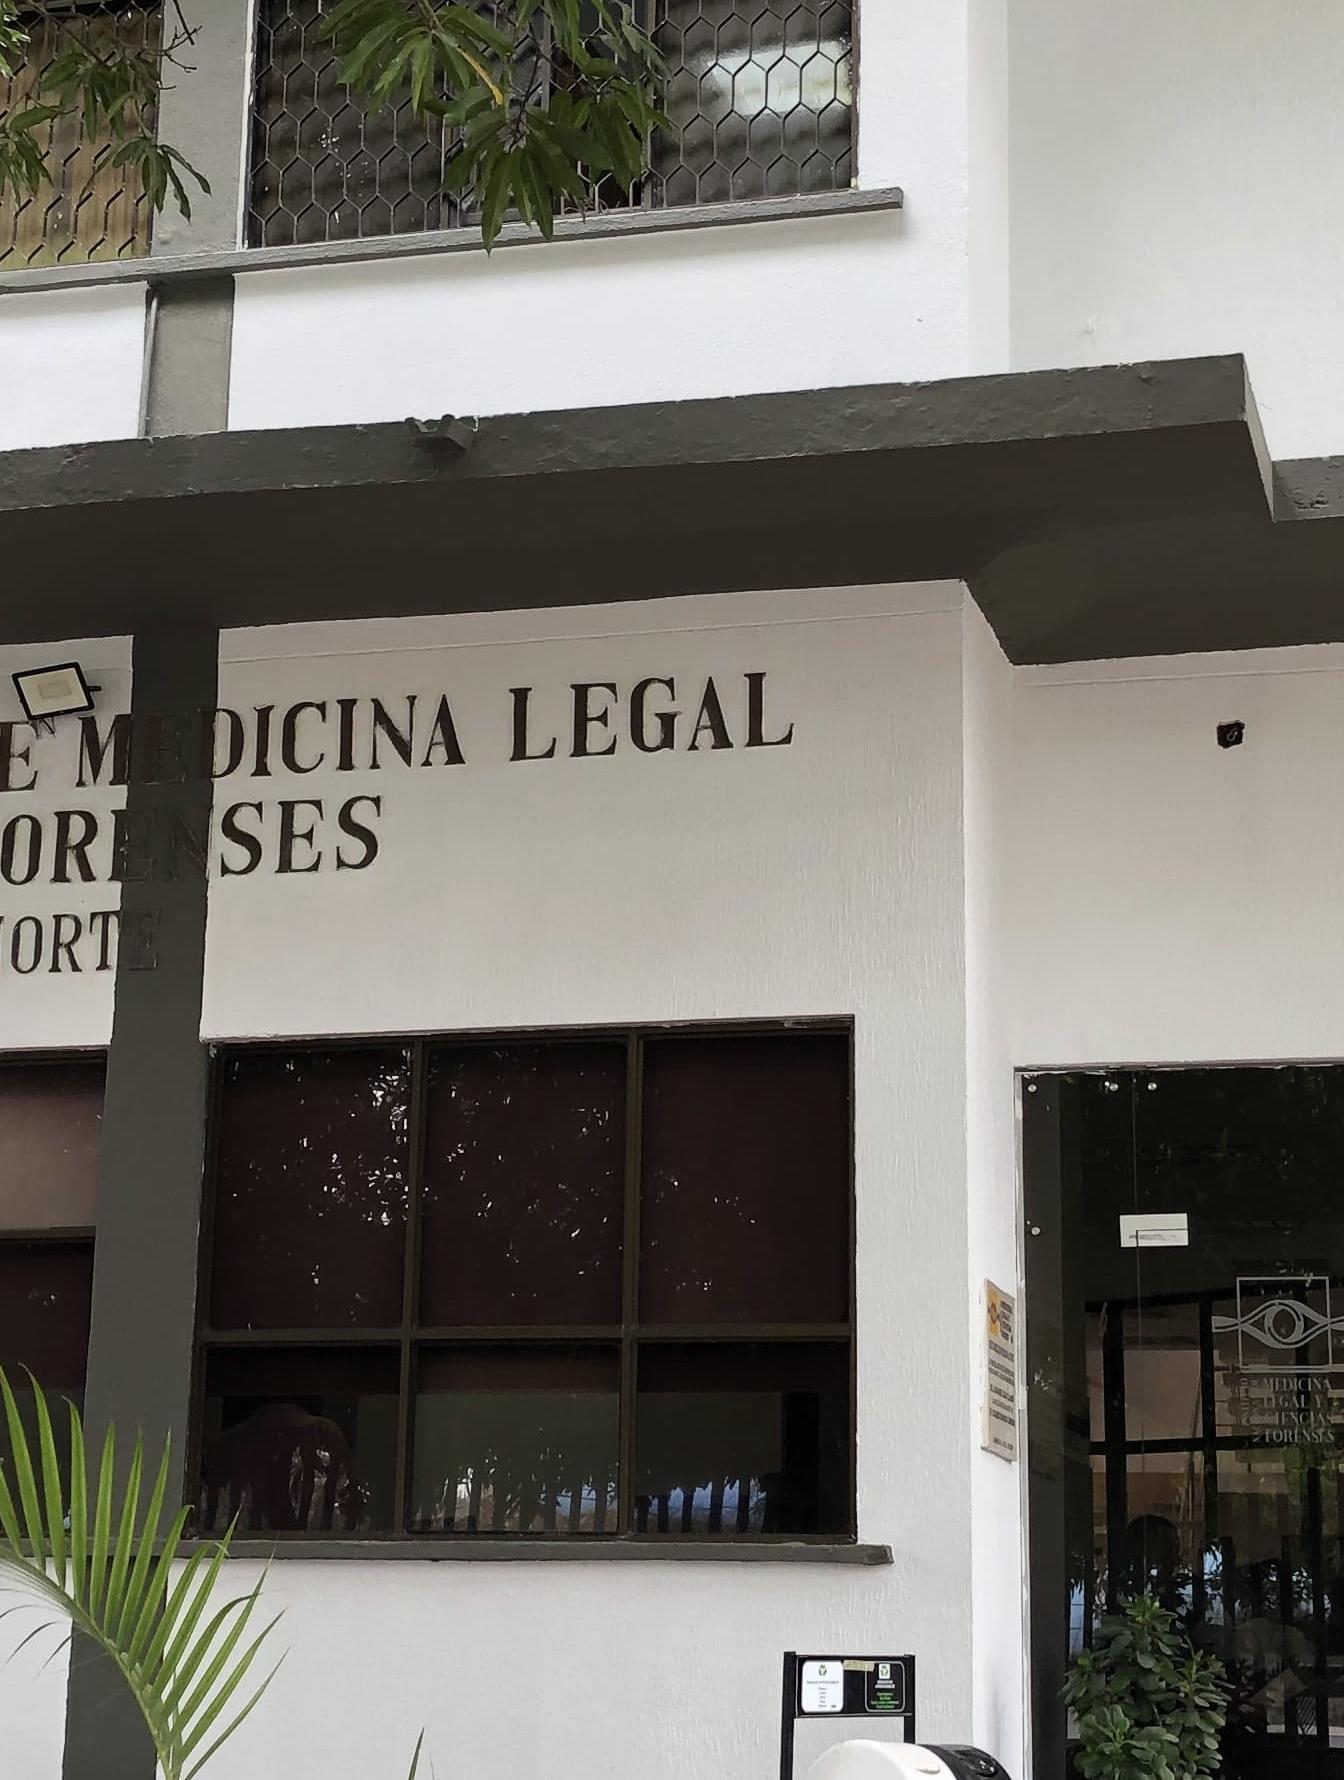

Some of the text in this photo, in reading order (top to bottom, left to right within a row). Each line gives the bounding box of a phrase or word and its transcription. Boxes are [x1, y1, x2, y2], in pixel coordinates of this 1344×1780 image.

[75, 693, 464, 788] MEDICINA
[509, 672, 795, 763] LEGAL
[1263, 1377, 1332, 1391] MEDICINA
[1265, 1428, 1334, 1443] FORENSES
